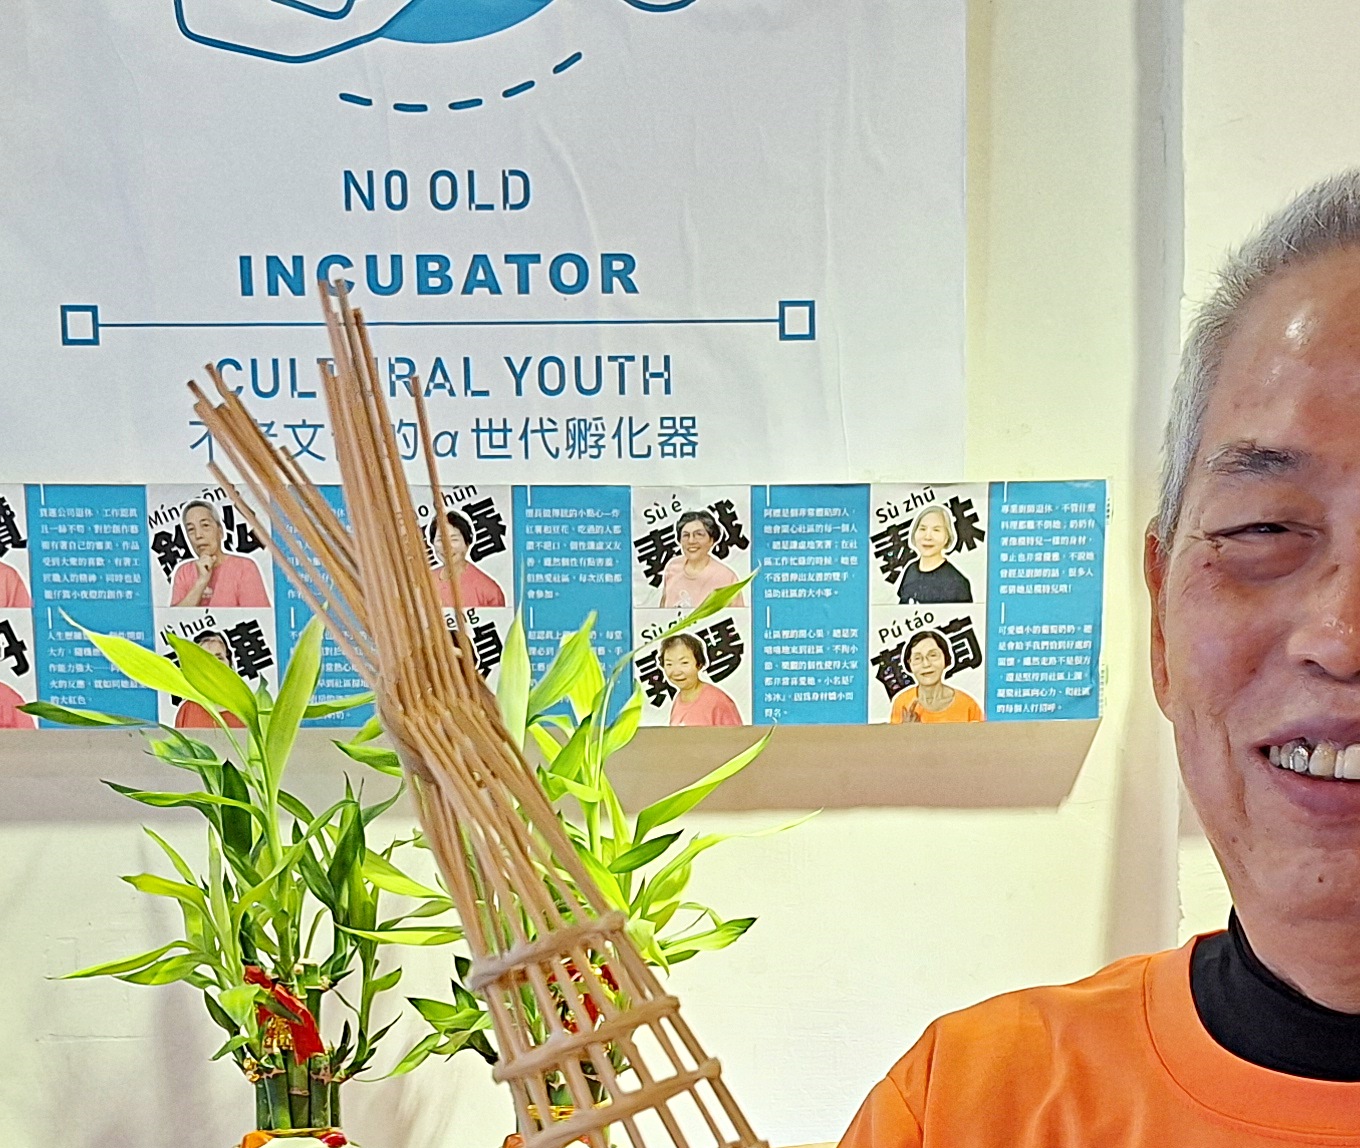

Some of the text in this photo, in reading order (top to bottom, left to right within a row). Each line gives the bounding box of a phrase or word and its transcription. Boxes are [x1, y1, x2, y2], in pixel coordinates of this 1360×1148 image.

[429, 169, 531, 212] OLD
[239, 253, 640, 297] INCUBATOR
[504, 354, 673, 398] YOUTH
[643, 502, 668, 525] Sù
[875, 501, 900, 524] Sù
[179, 608, 217, 638] huá
[878, 610, 934, 643] Pú táo
